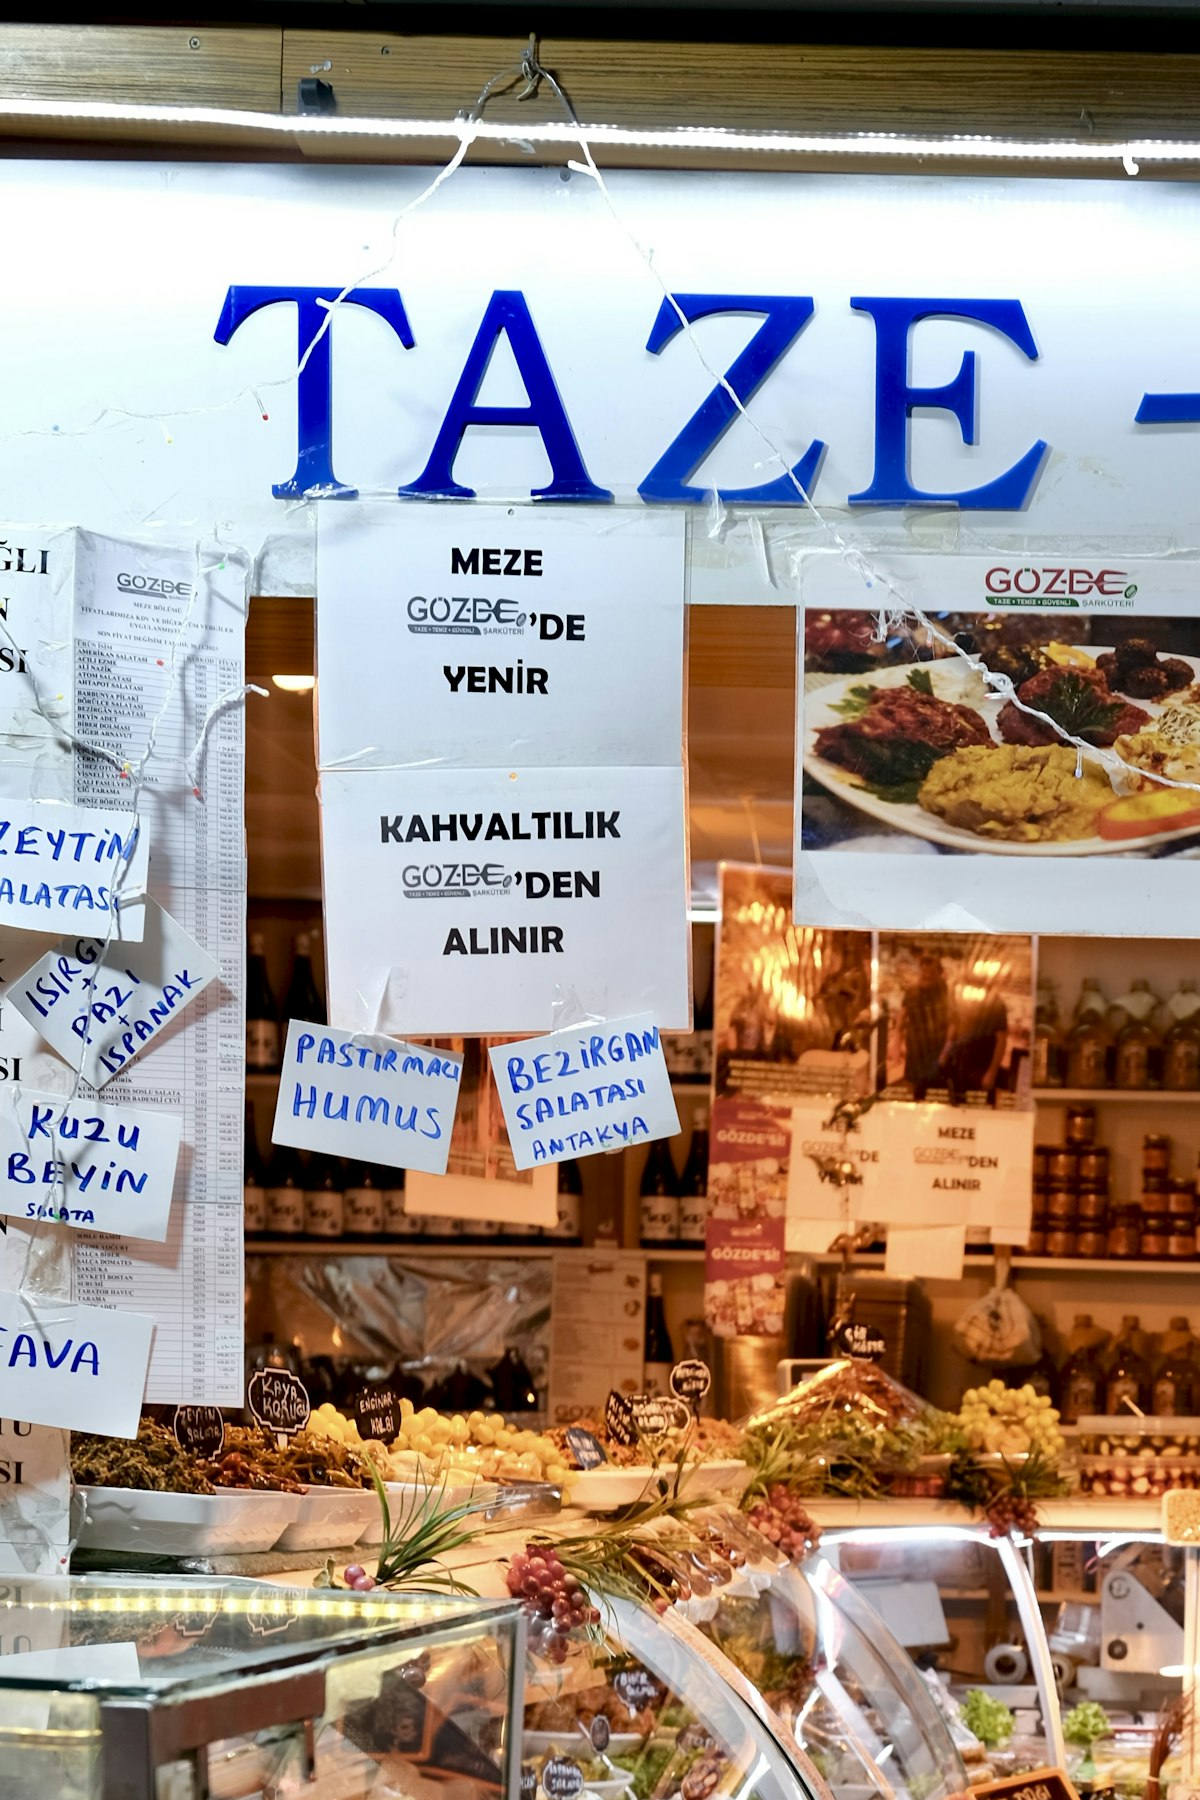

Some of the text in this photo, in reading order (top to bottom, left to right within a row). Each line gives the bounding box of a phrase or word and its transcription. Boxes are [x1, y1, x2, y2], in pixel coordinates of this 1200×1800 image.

[213, 284, 1052, 512] TAZE
[450, 547, 543, 576] MEZE
[985, 567, 1128, 595] GÖZDE
[406, 595, 519, 624] GÖZDE
[1082, 599, 1135, 608] ŞARKÜTERİ
[483, 626, 525, 636] ŞARKÜTERİ
[443, 659, 549, 694] YENİR
[380, 811, 621, 843] KAHVALTILIK
[402, 863, 505, 888] GÖZDE
[472, 889, 511, 897] ŞARKÜTERİ
[443, 926, 564, 955] ALINIR
[71, 969, 141, 1044] PAZI
[98, 969, 203, 1074] ISPANAK
[292, 1083, 443, 1140] HUMUS
[516, 1079, 647, 1131] SALATASI
[532, 1116, 650, 1161] ANTAKYA
[938, 1126, 976, 1140] MEZE
[932, 1178, 981, 1191] ALINIR
